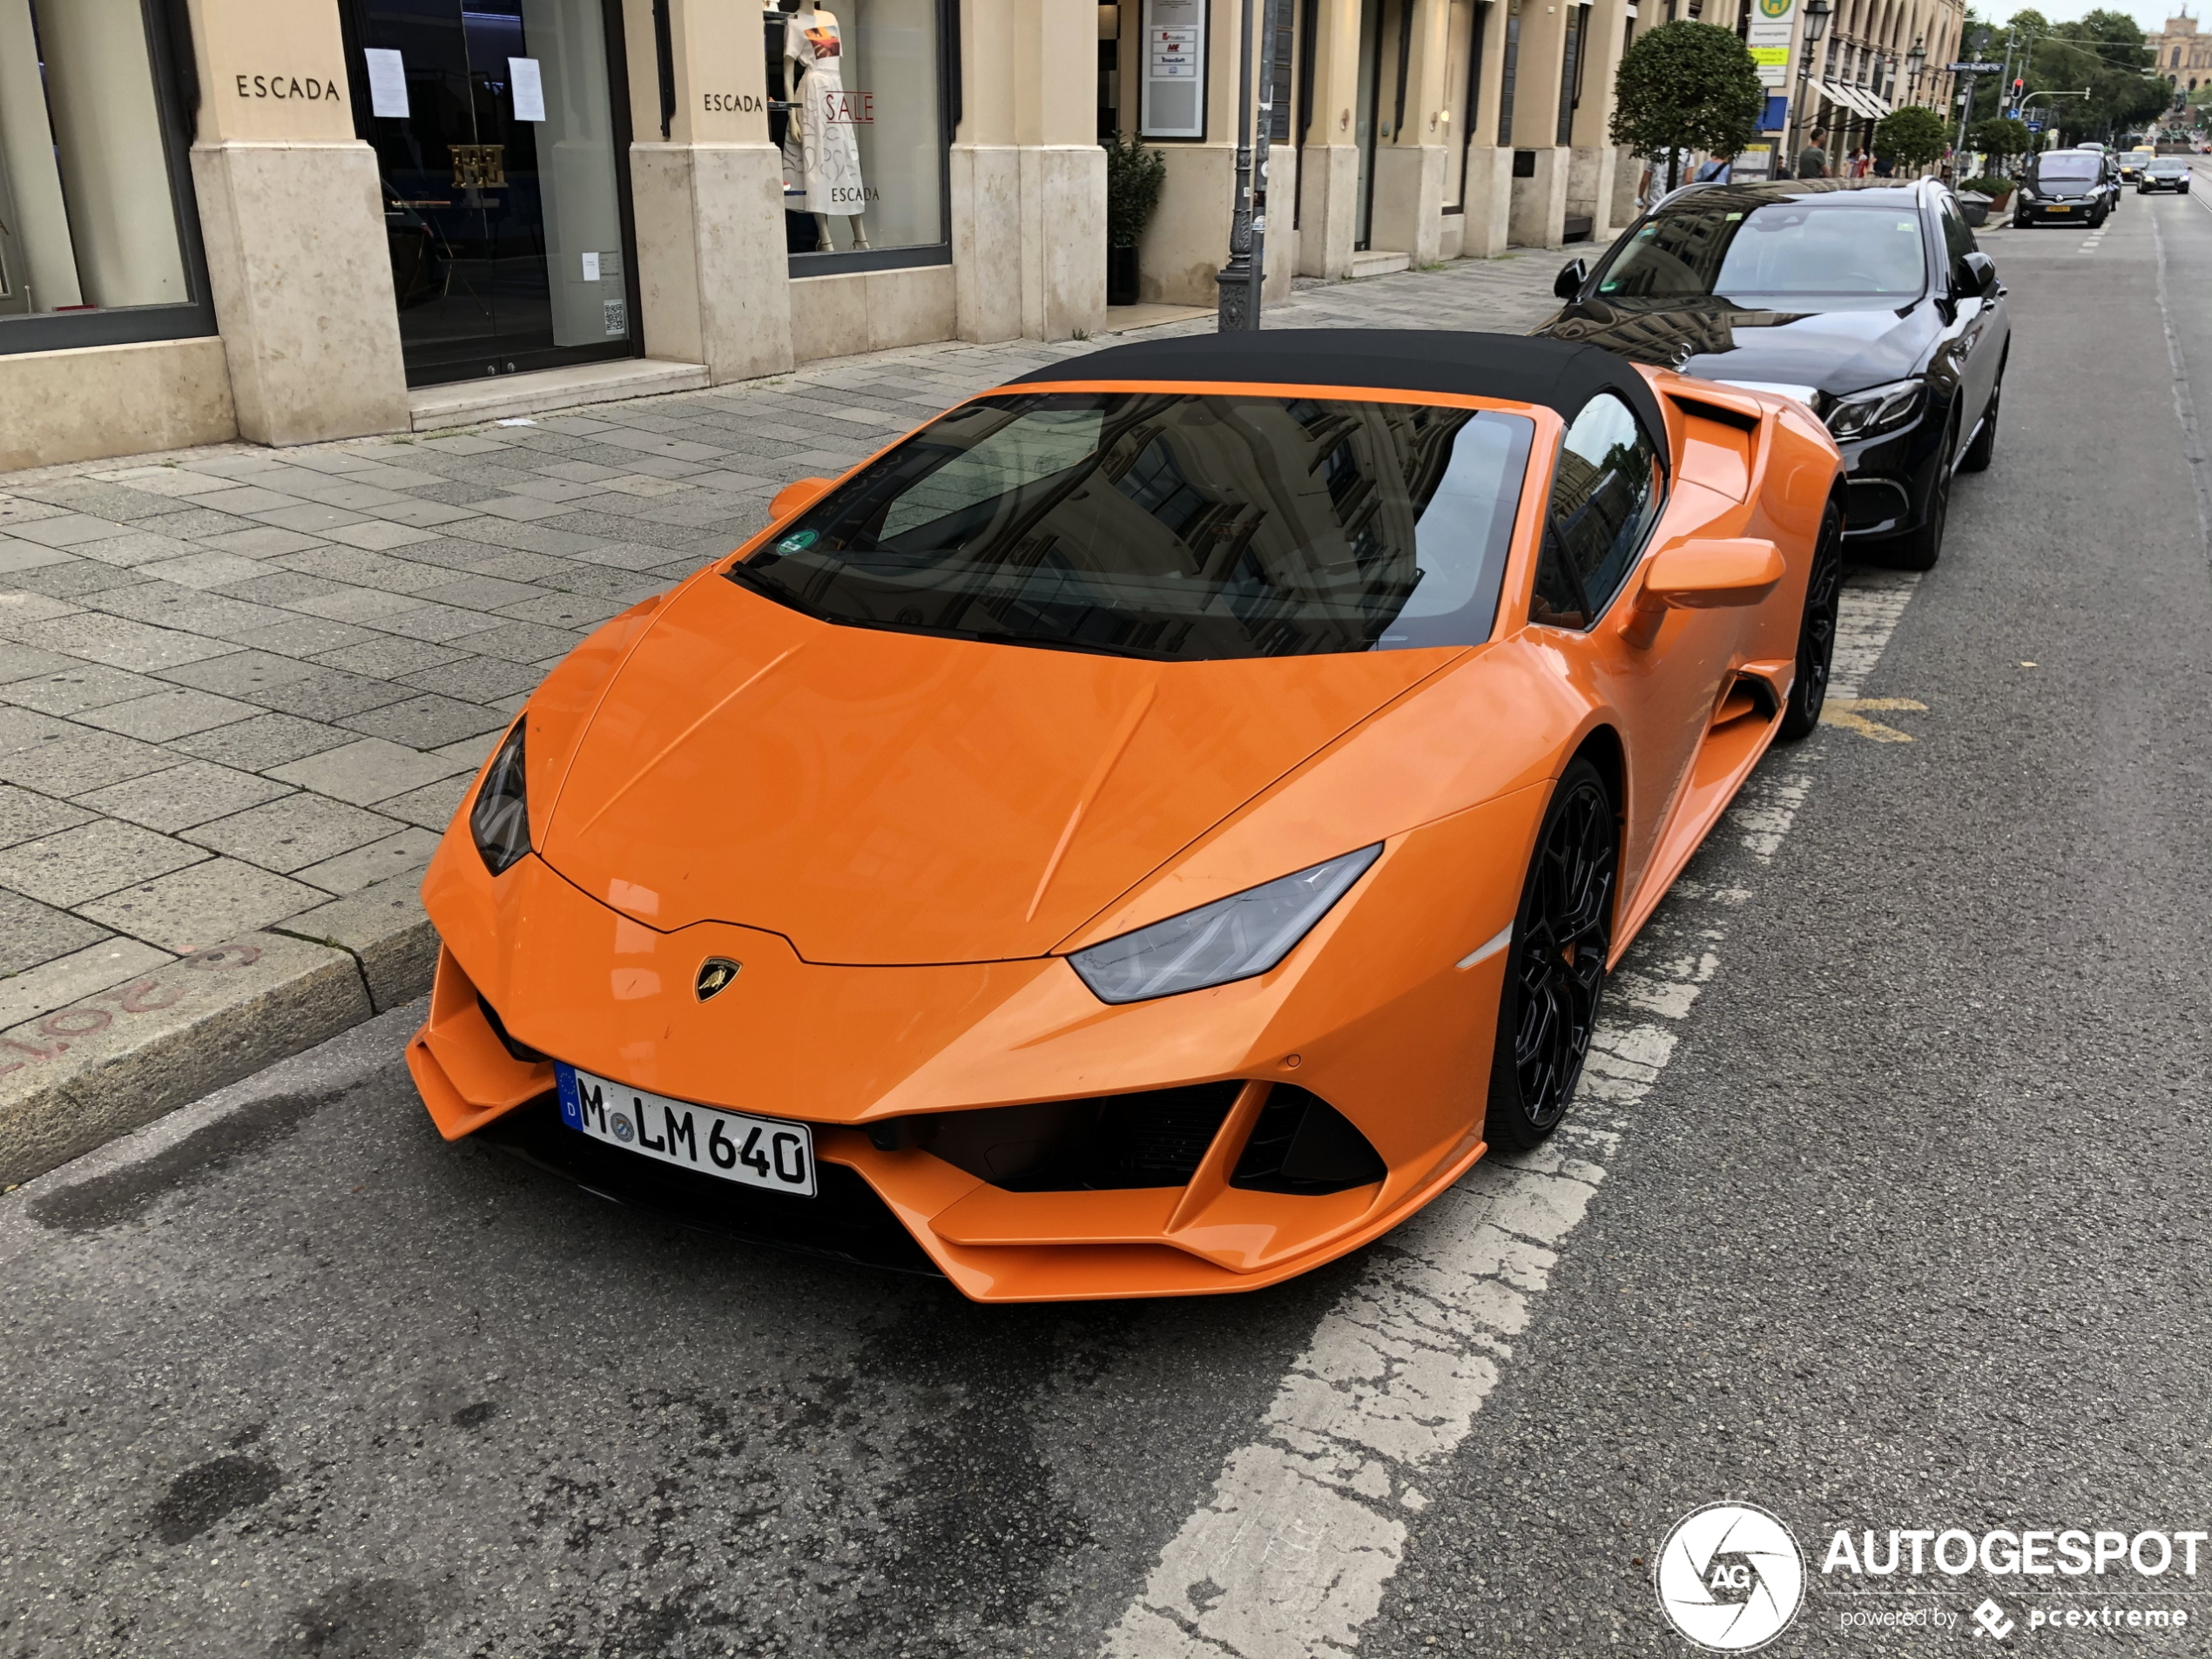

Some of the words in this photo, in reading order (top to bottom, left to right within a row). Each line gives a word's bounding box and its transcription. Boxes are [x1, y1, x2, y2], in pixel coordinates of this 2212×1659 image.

[236, 75, 340, 101] ESCADA
[704, 93, 763, 112] ESCADA
[825, 93, 873, 121] SALE
[832, 187, 880, 202] ESCADA
[567, 1102, 577, 1117] D
[577, 1077, 607, 1134] M
